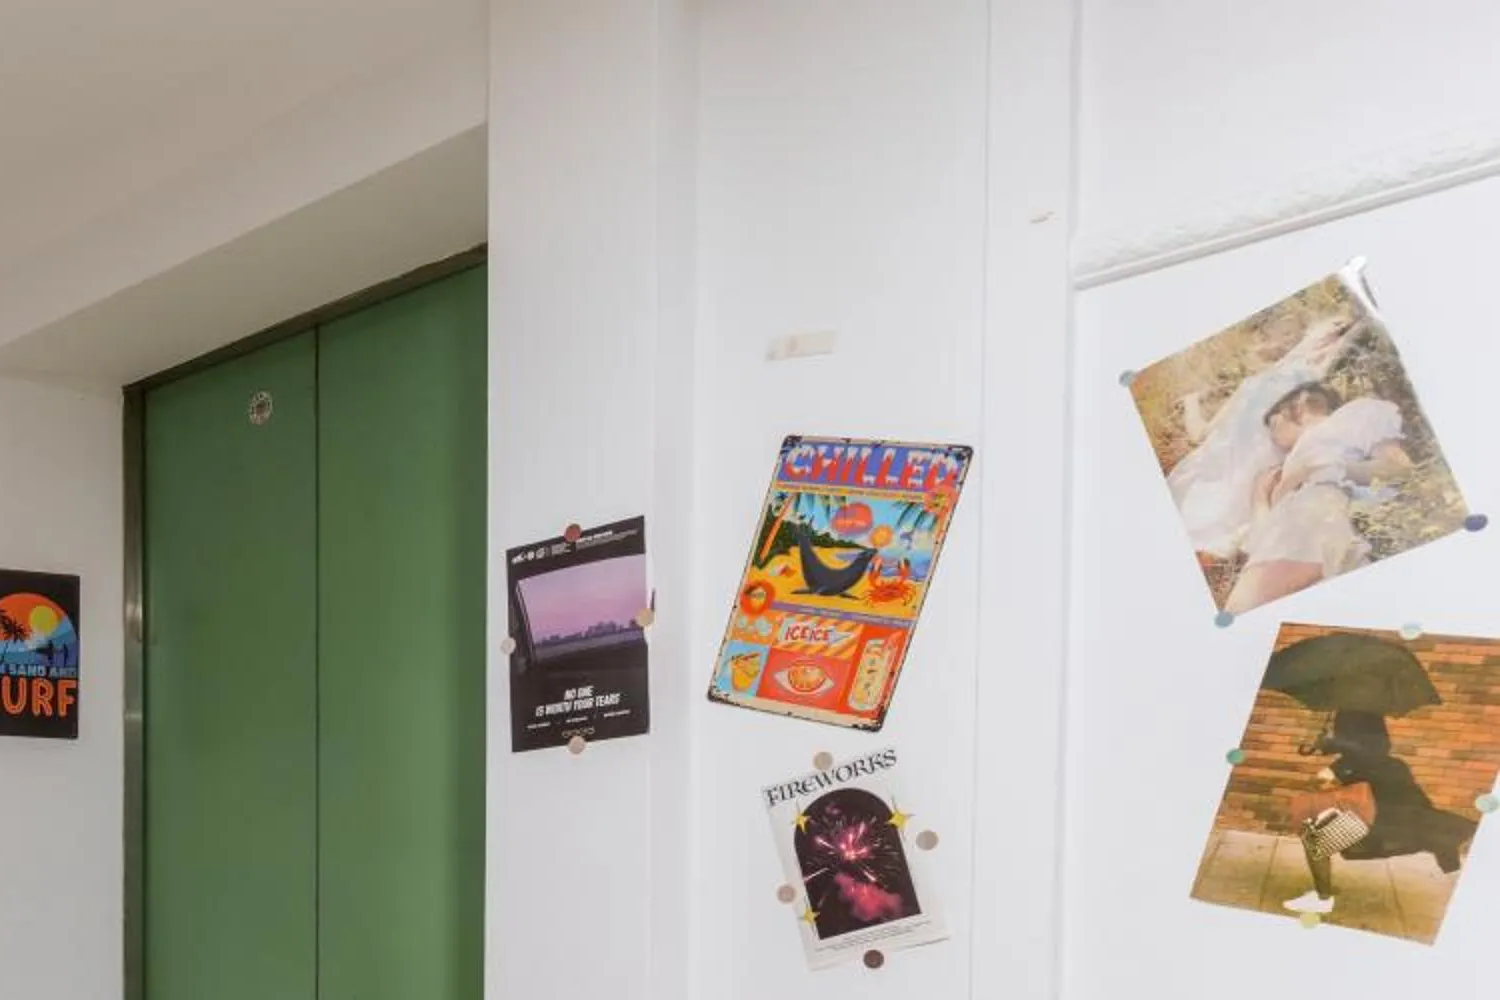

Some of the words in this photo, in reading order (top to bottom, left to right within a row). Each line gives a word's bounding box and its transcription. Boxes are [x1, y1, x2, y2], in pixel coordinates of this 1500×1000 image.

[784, 444, 958, 489] CHILLED
[9, 663, 47, 677] SAND
[535, 705, 545, 717] IS
[595, 693, 621, 707] TEARS
[564, 688, 577, 700] NO
[763, 748, 898, 807] FIREWORKS
